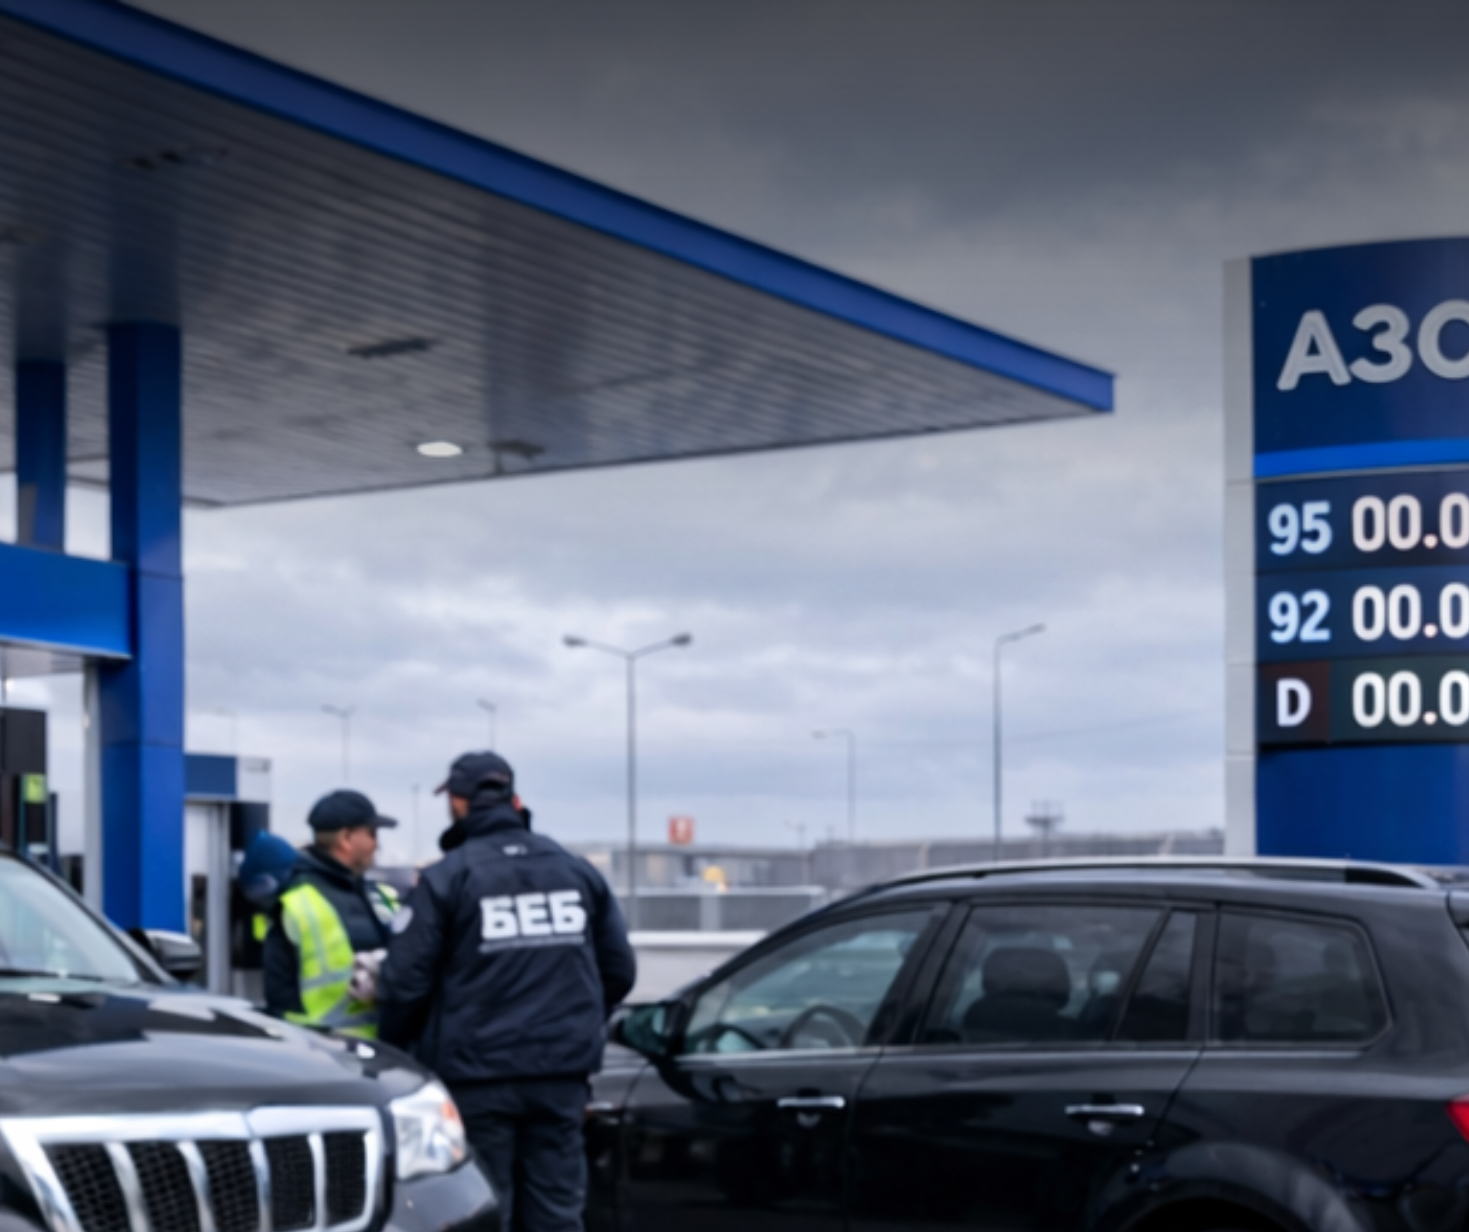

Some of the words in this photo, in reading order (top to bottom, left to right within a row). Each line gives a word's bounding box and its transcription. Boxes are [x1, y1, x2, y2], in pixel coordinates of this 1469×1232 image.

[1269, 500, 1333, 555] 95
[1269, 589, 1332, 643] 92
[1276, 677, 1311, 727] D
[480, 890, 586, 940] БЕБ
